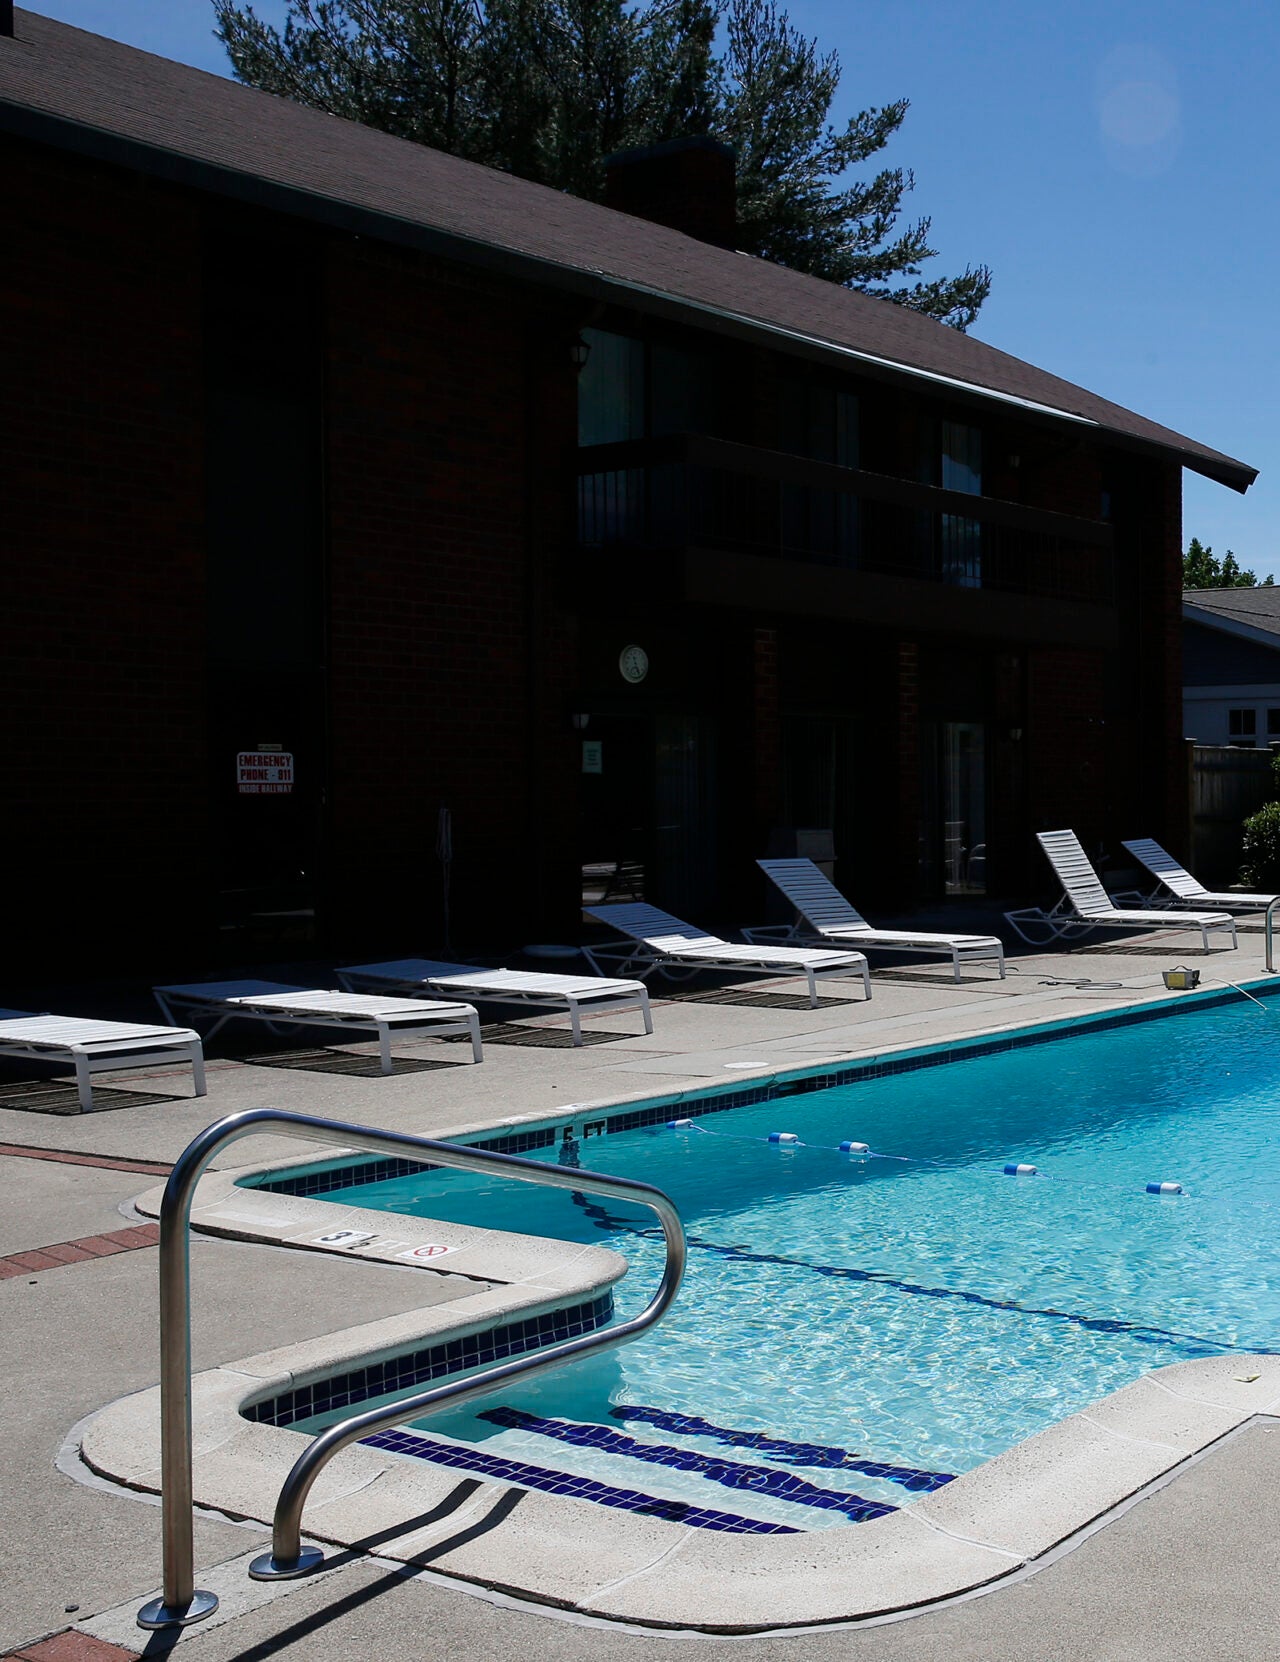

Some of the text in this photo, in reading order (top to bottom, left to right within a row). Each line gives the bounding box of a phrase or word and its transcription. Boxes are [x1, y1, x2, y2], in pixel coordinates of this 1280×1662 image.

[239, 755, 291, 766] EMERGENCY
[240, 769, 269, 780] PHONE
[278, 769, 291, 780] 911
[262, 784, 292, 793] HALLWAY
[583, 1119, 605, 1139] FT
[321, 1232, 353, 1241] 3
